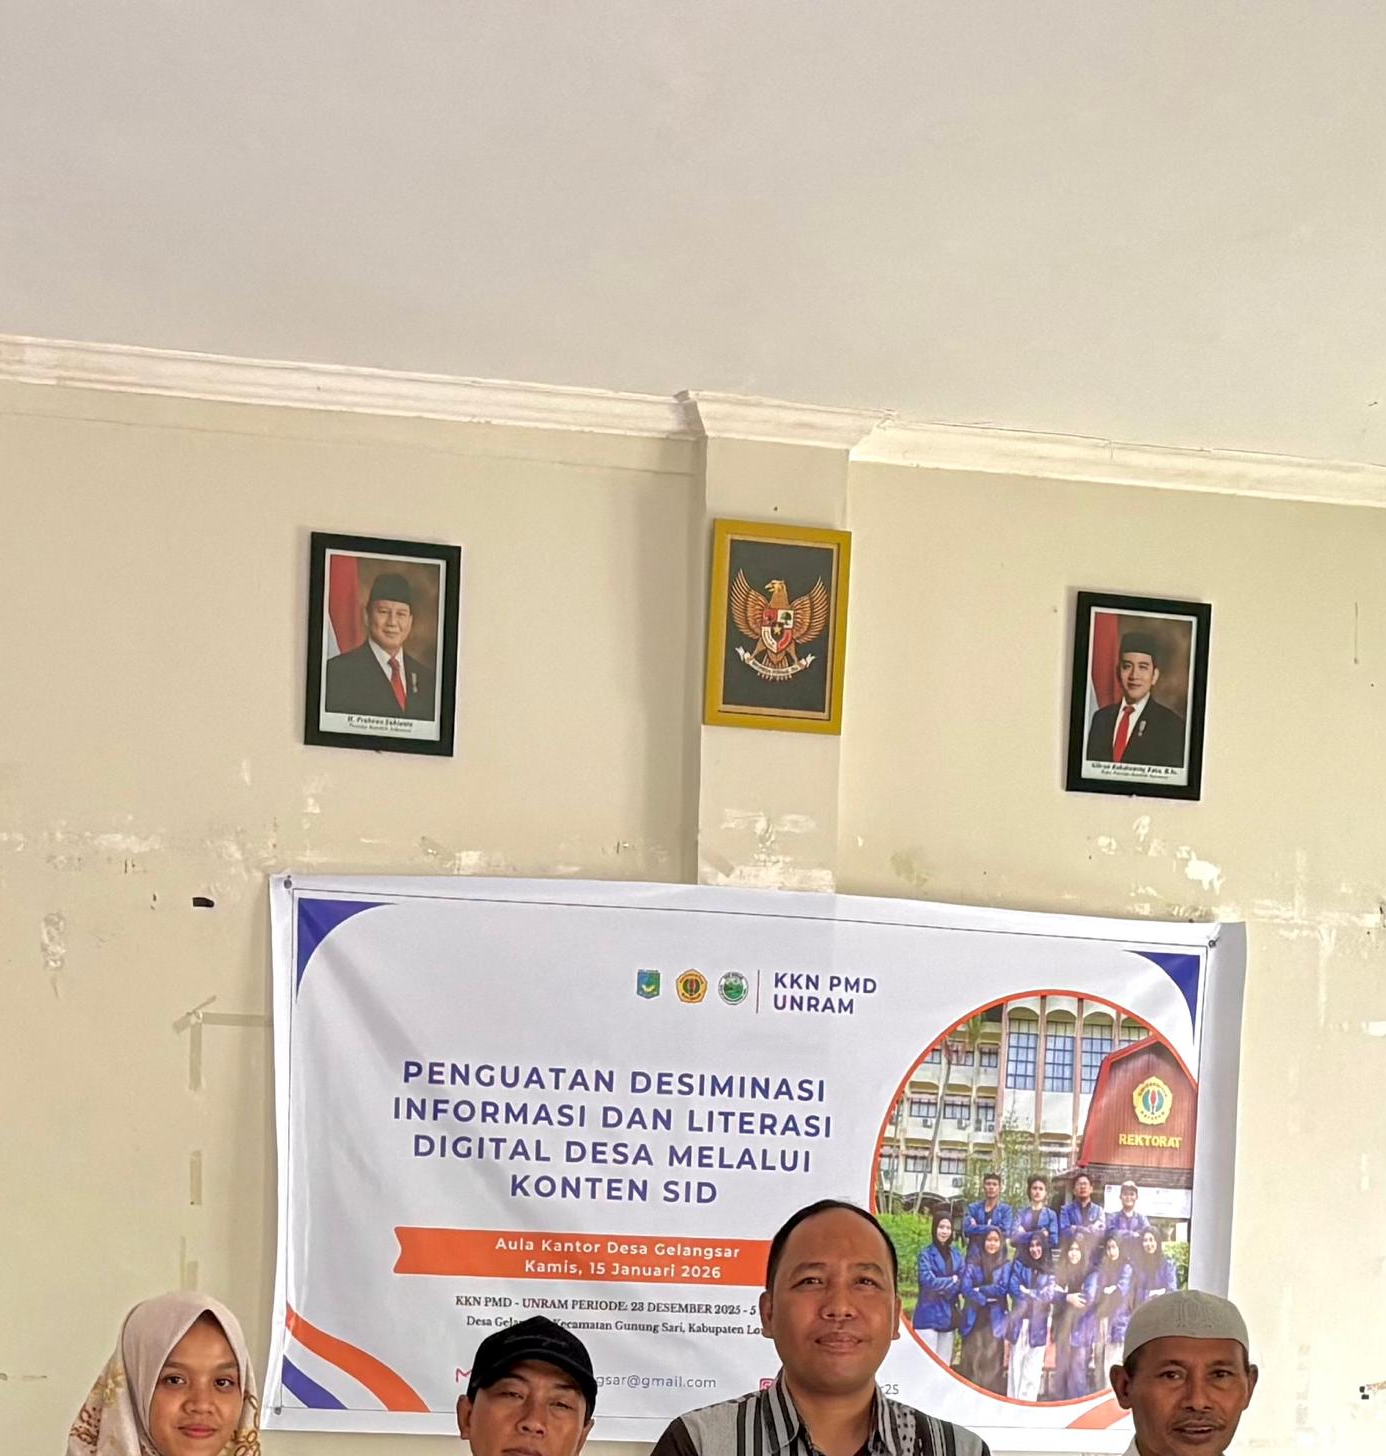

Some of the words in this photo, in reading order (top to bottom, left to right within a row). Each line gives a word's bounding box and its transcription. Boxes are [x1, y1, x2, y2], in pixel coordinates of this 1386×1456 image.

[774, 972, 819, 990] KKN
[828, 975, 877, 994] PMD
[773, 993, 854, 1014] UNRAM
[403, 1061, 615, 1093] PENGUATAN
[630, 1071, 826, 1103] DESIMINASI
[393, 1097, 586, 1128] INFORMASI
[602, 1106, 673, 1132] DAN
[688, 1110, 832, 1138] LITERASI
[1119, 1133, 1182, 1149] REKTORAT
[413, 1134, 551, 1163] DIGITAL
[565, 1141, 654, 1167] DESA
[668, 1144, 811, 1172] MELALUI
[511, 1174, 648, 1202] KONTEN
[663, 1180, 718, 1204] SID
[495, 1237, 534, 1251] Aula
[541, 1239, 601, 1253] Kantor
[607, 1241, 648, 1255] Desa
[654, 1243, 740, 1260] Gelangsar
[525, 1259, 583, 1275] Kamis,
[589, 1261, 606, 1275] 15
[611, 1263, 675, 1278] Januari
[681, 1265, 722, 1279] 2026
[455, 1295, 482, 1306] KKN
[484, 1296, 512, 1308] PMD
[522, 1297, 569, 1310] UNRAM
[646, 1302, 713, 1314] DESEMBER
[714, 1304, 741, 1315] 2025
[466, 1315, 493, 1326] Desa
[614, 1320, 659, 1334] Gunung
[661, 1322, 686, 1333] Sari,
[688, 1323, 744, 1337] Kabupaten
[746, 1325, 763, 1335] Lo
